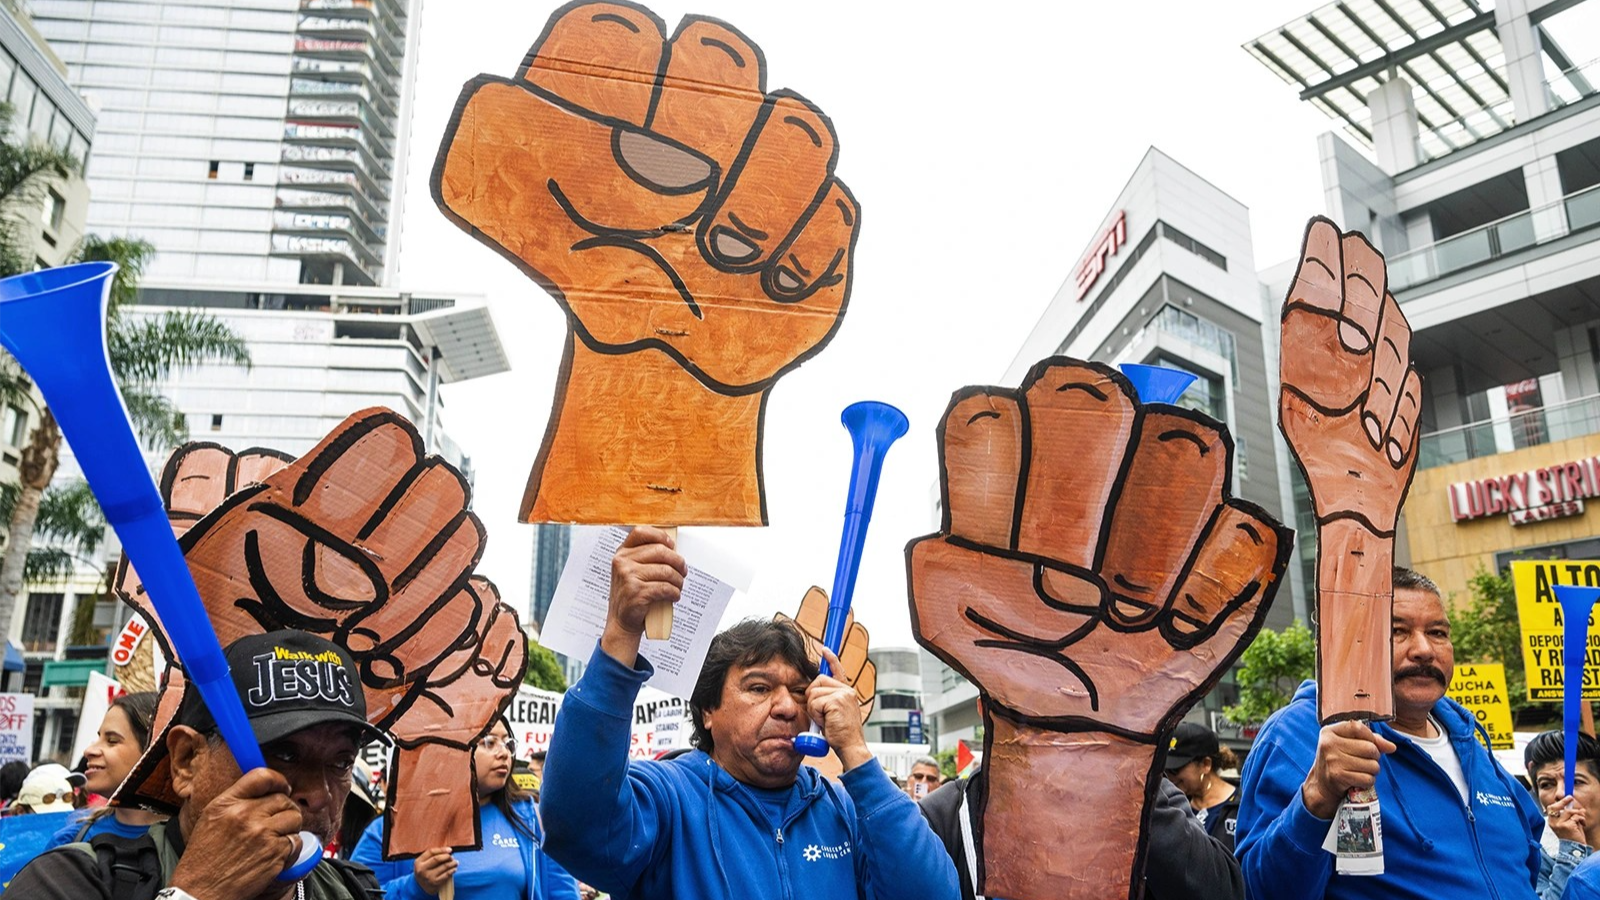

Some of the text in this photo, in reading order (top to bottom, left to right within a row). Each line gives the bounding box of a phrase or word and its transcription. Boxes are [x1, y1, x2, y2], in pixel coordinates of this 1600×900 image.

[1076, 209, 1127, 303] ESPN
[1449, 471, 1529, 522] LUCKY
[1510, 499, 1582, 524] LANES
[114, 620, 145, 662] ONE
[274, 646, 342, 666] Walk with
[1532, 649, 1542, 667] Y
[248, 651, 355, 707] JESUS
[1460, 667, 1477, 677] LA
[1541, 668, 1600, 687] RAST
[1449, 680, 1495, 692] LUCHA
[1450, 694, 1502, 706] BRERA
[525, 731, 552, 744] FU
